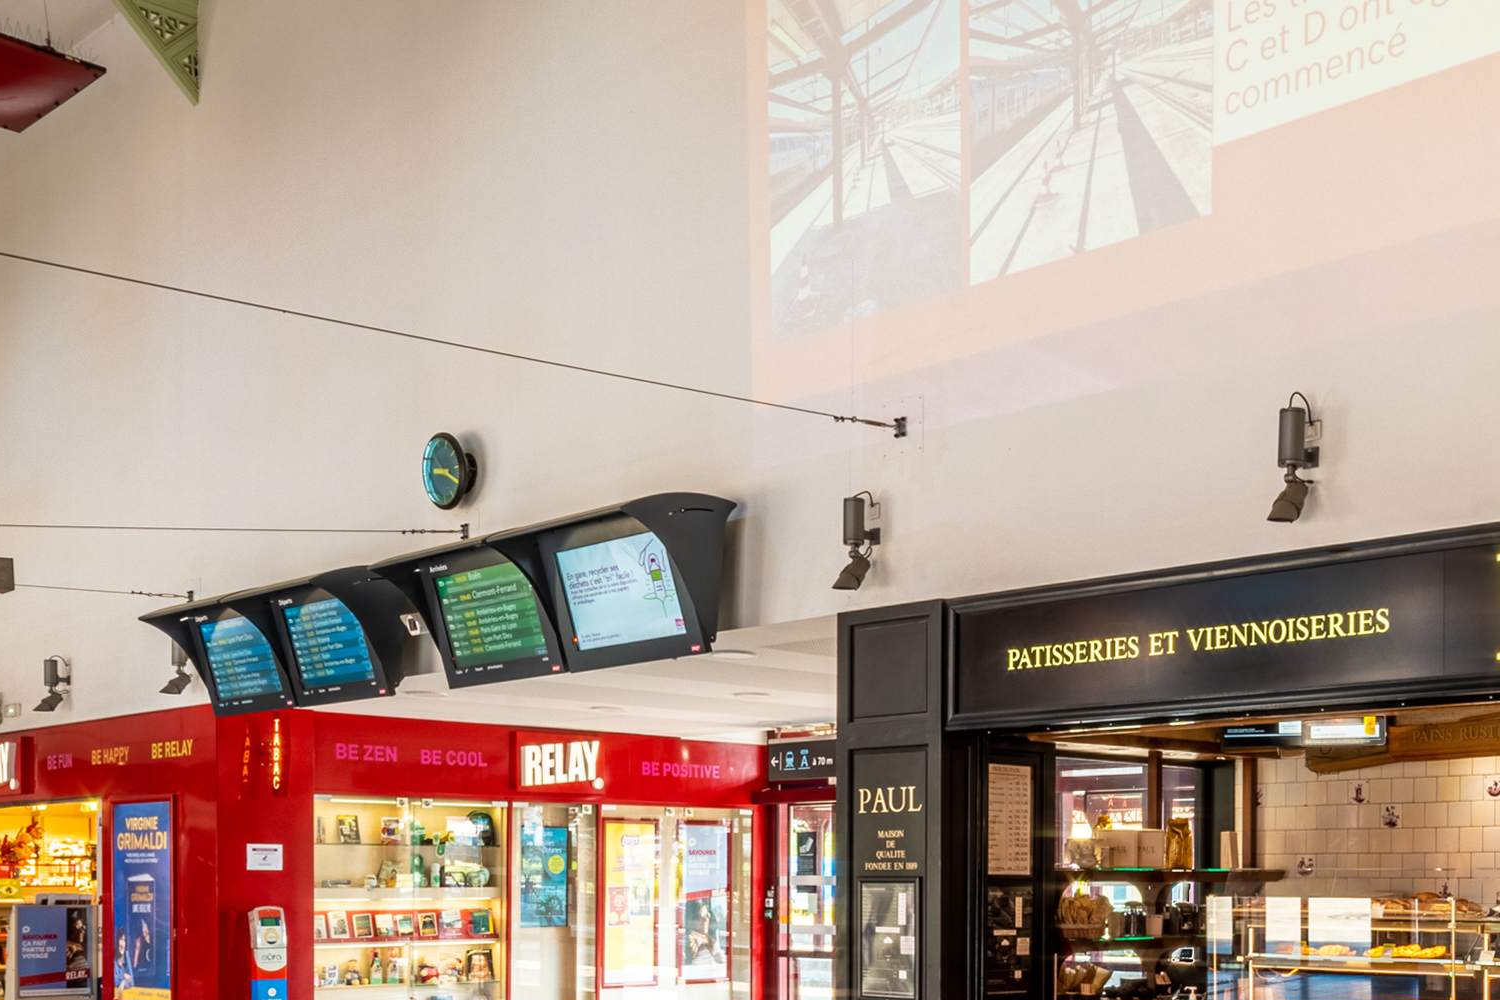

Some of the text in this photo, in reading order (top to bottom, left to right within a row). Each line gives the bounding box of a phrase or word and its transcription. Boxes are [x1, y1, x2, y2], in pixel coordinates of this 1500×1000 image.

[1227, 0, 1277, 32] Les
[1226, 0, 1395, 72] C et D ont
[1225, 22, 1407, 115] commencé
[566, 572, 574, 580] En
[588, 566, 609, 577] recycler
[472, 583, 517, 599] Clermont-Ferrand
[569, 579, 589, 590] déchets
[1007, 607, 1390, 671] PATISSERIES ET VIENNOISERIES
[1411, 728, 1453, 743] PAINS
[47, 739, 193, 770] BE FUN BE HAPPY BE RELAY
[335, 743, 488, 768] BE ZEN BE COOL
[812, 757, 817, 766] à
[817, 756, 827, 766] 70
[826, 757, 833, 765] m
[641, 761, 720, 780] BE POSITIVE
[858, 785, 923, 813] PAUL
[125, 816, 159, 831] VIRGINIE
[117, 831, 167, 851] GRIMALDI
[877, 830, 904, 838] MAISON
[885, 840, 896, 848] DE
[875, 850, 906, 859] QUALITE
[865, 862, 893, 870] FONDEE
[894, 862, 904, 870] EN
